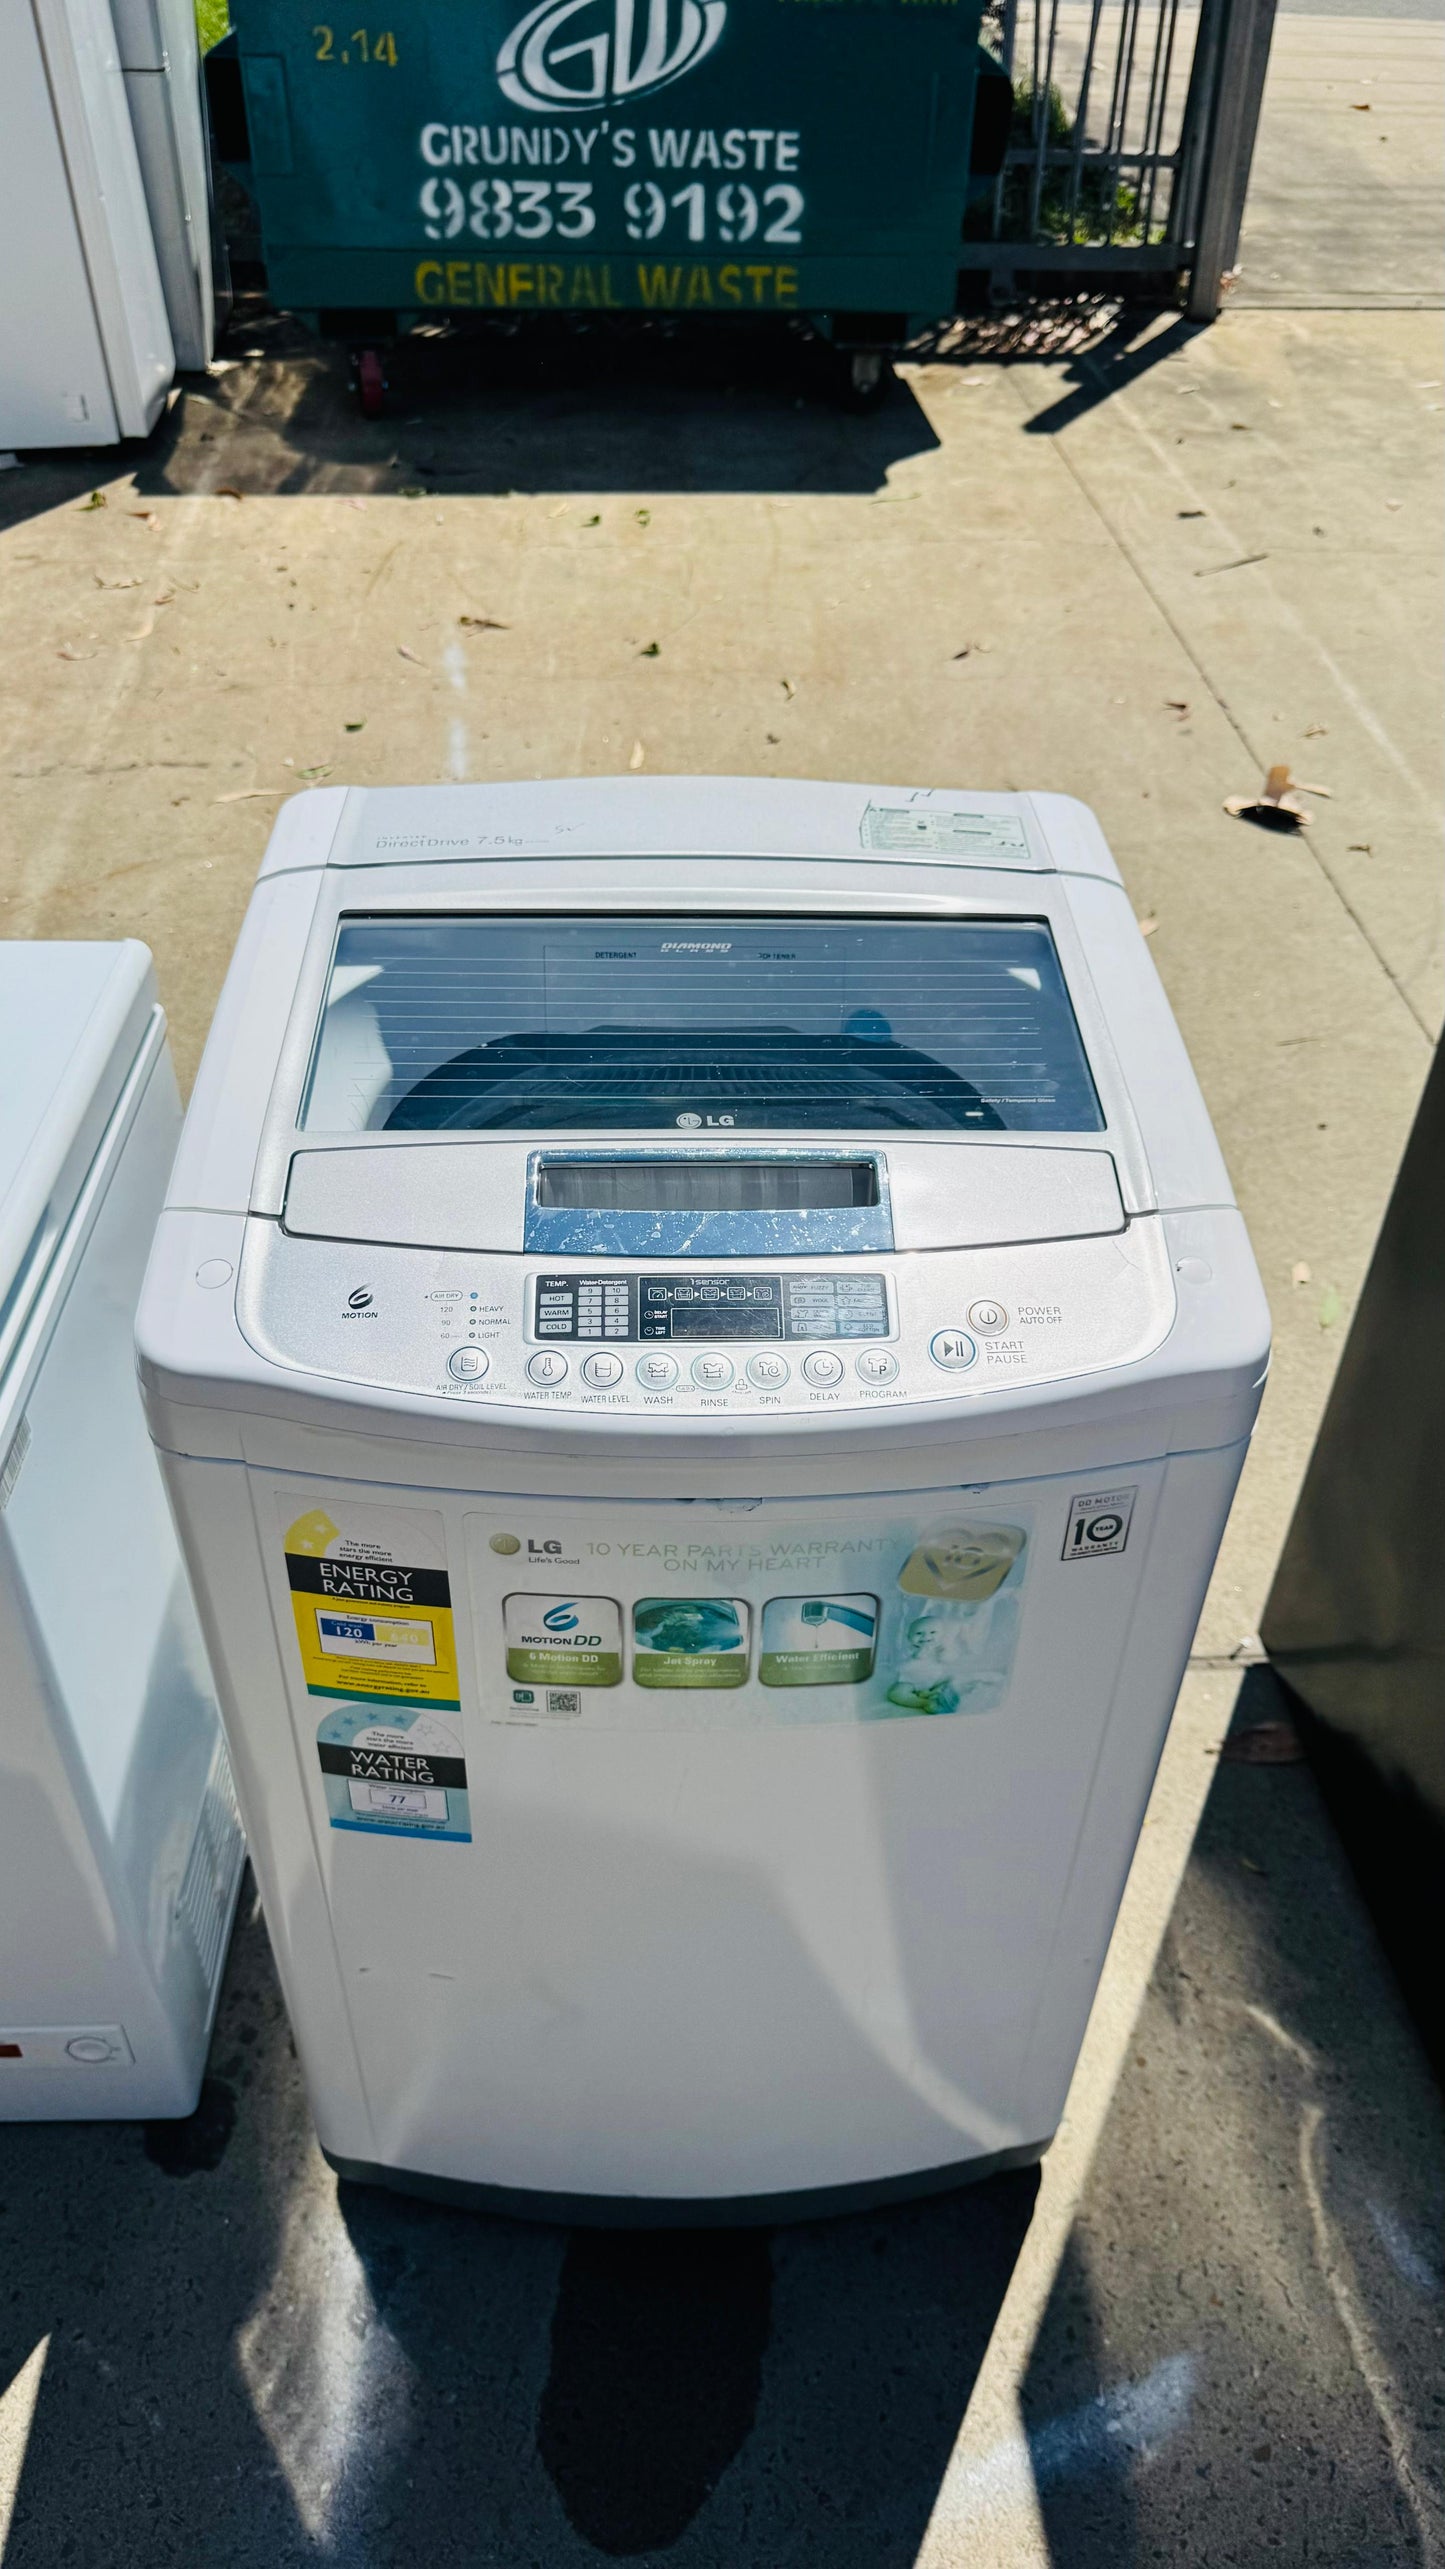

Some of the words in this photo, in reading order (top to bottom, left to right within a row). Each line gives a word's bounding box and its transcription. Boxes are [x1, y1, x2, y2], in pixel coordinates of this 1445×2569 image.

[420, 121, 636, 168] GRUNDY'S
[648, 129, 801, 171] WASTE
[420, 177, 597, 239] 9833
[624, 182, 804, 243] 9192
[415, 261, 622, 308] GENERAL
[637, 263, 799, 308] WASTE
[477, 836, 504, 845] 7.5
[508, 836, 524, 846] kg
[706, 1115, 735, 1126] LG
[1017, 1307, 1061, 1316] POWER
[985, 1341, 1024, 1350] START
[986, 1355, 1028, 1364] PAUSE
[524, 1392, 549, 1400] WATER
[581, 1395, 606, 1403] WATER
[607, 1395, 630, 1403] LEVEL
[643, 1396, 673, 1404] WASH
[809, 1392, 840, 1401] DELAY
[859, 1391, 908, 1399] PROGRAM
[700, 1399, 729, 1407] RINSE
[759, 1397, 781, 1405] SPIN
[1074, 1514, 1123, 1546] 10
[528, 1539, 562, 1554] LG
[586, 1542, 611, 1556] 10
[617, 1544, 678, 1557] YEAR
[688, 1544, 761, 1557] PARTS
[770, 1538, 900, 1556] WARRANTY
[554, 1557, 580, 1565] Good
[664, 1559, 698, 1571] ON
[707, 1559, 739, 1571] MY
[749, 1556, 826, 1571] HEART
[319, 1562, 413, 1586] ENERGY
[323, 1578, 414, 1602] RATING
[336, 1627, 363, 1638] 120
[521, 1635, 571, 1645] MOTION
[574, 1635, 602, 1646] DD
[529, 1652, 536, 1660] 6
[539, 1653, 578, 1662] Motion
[582, 1654, 599, 1663] DD
[664, 1657, 681, 1665] Jet
[684, 1657, 717, 1667] Spray
[776, 1655, 809, 1663] Water
[812, 1652, 859, 1662] Efficient
[350, 1750, 430, 1770] WATER
[351, 1763, 435, 1784] RATING
[389, 1794, 406, 1804] 77
